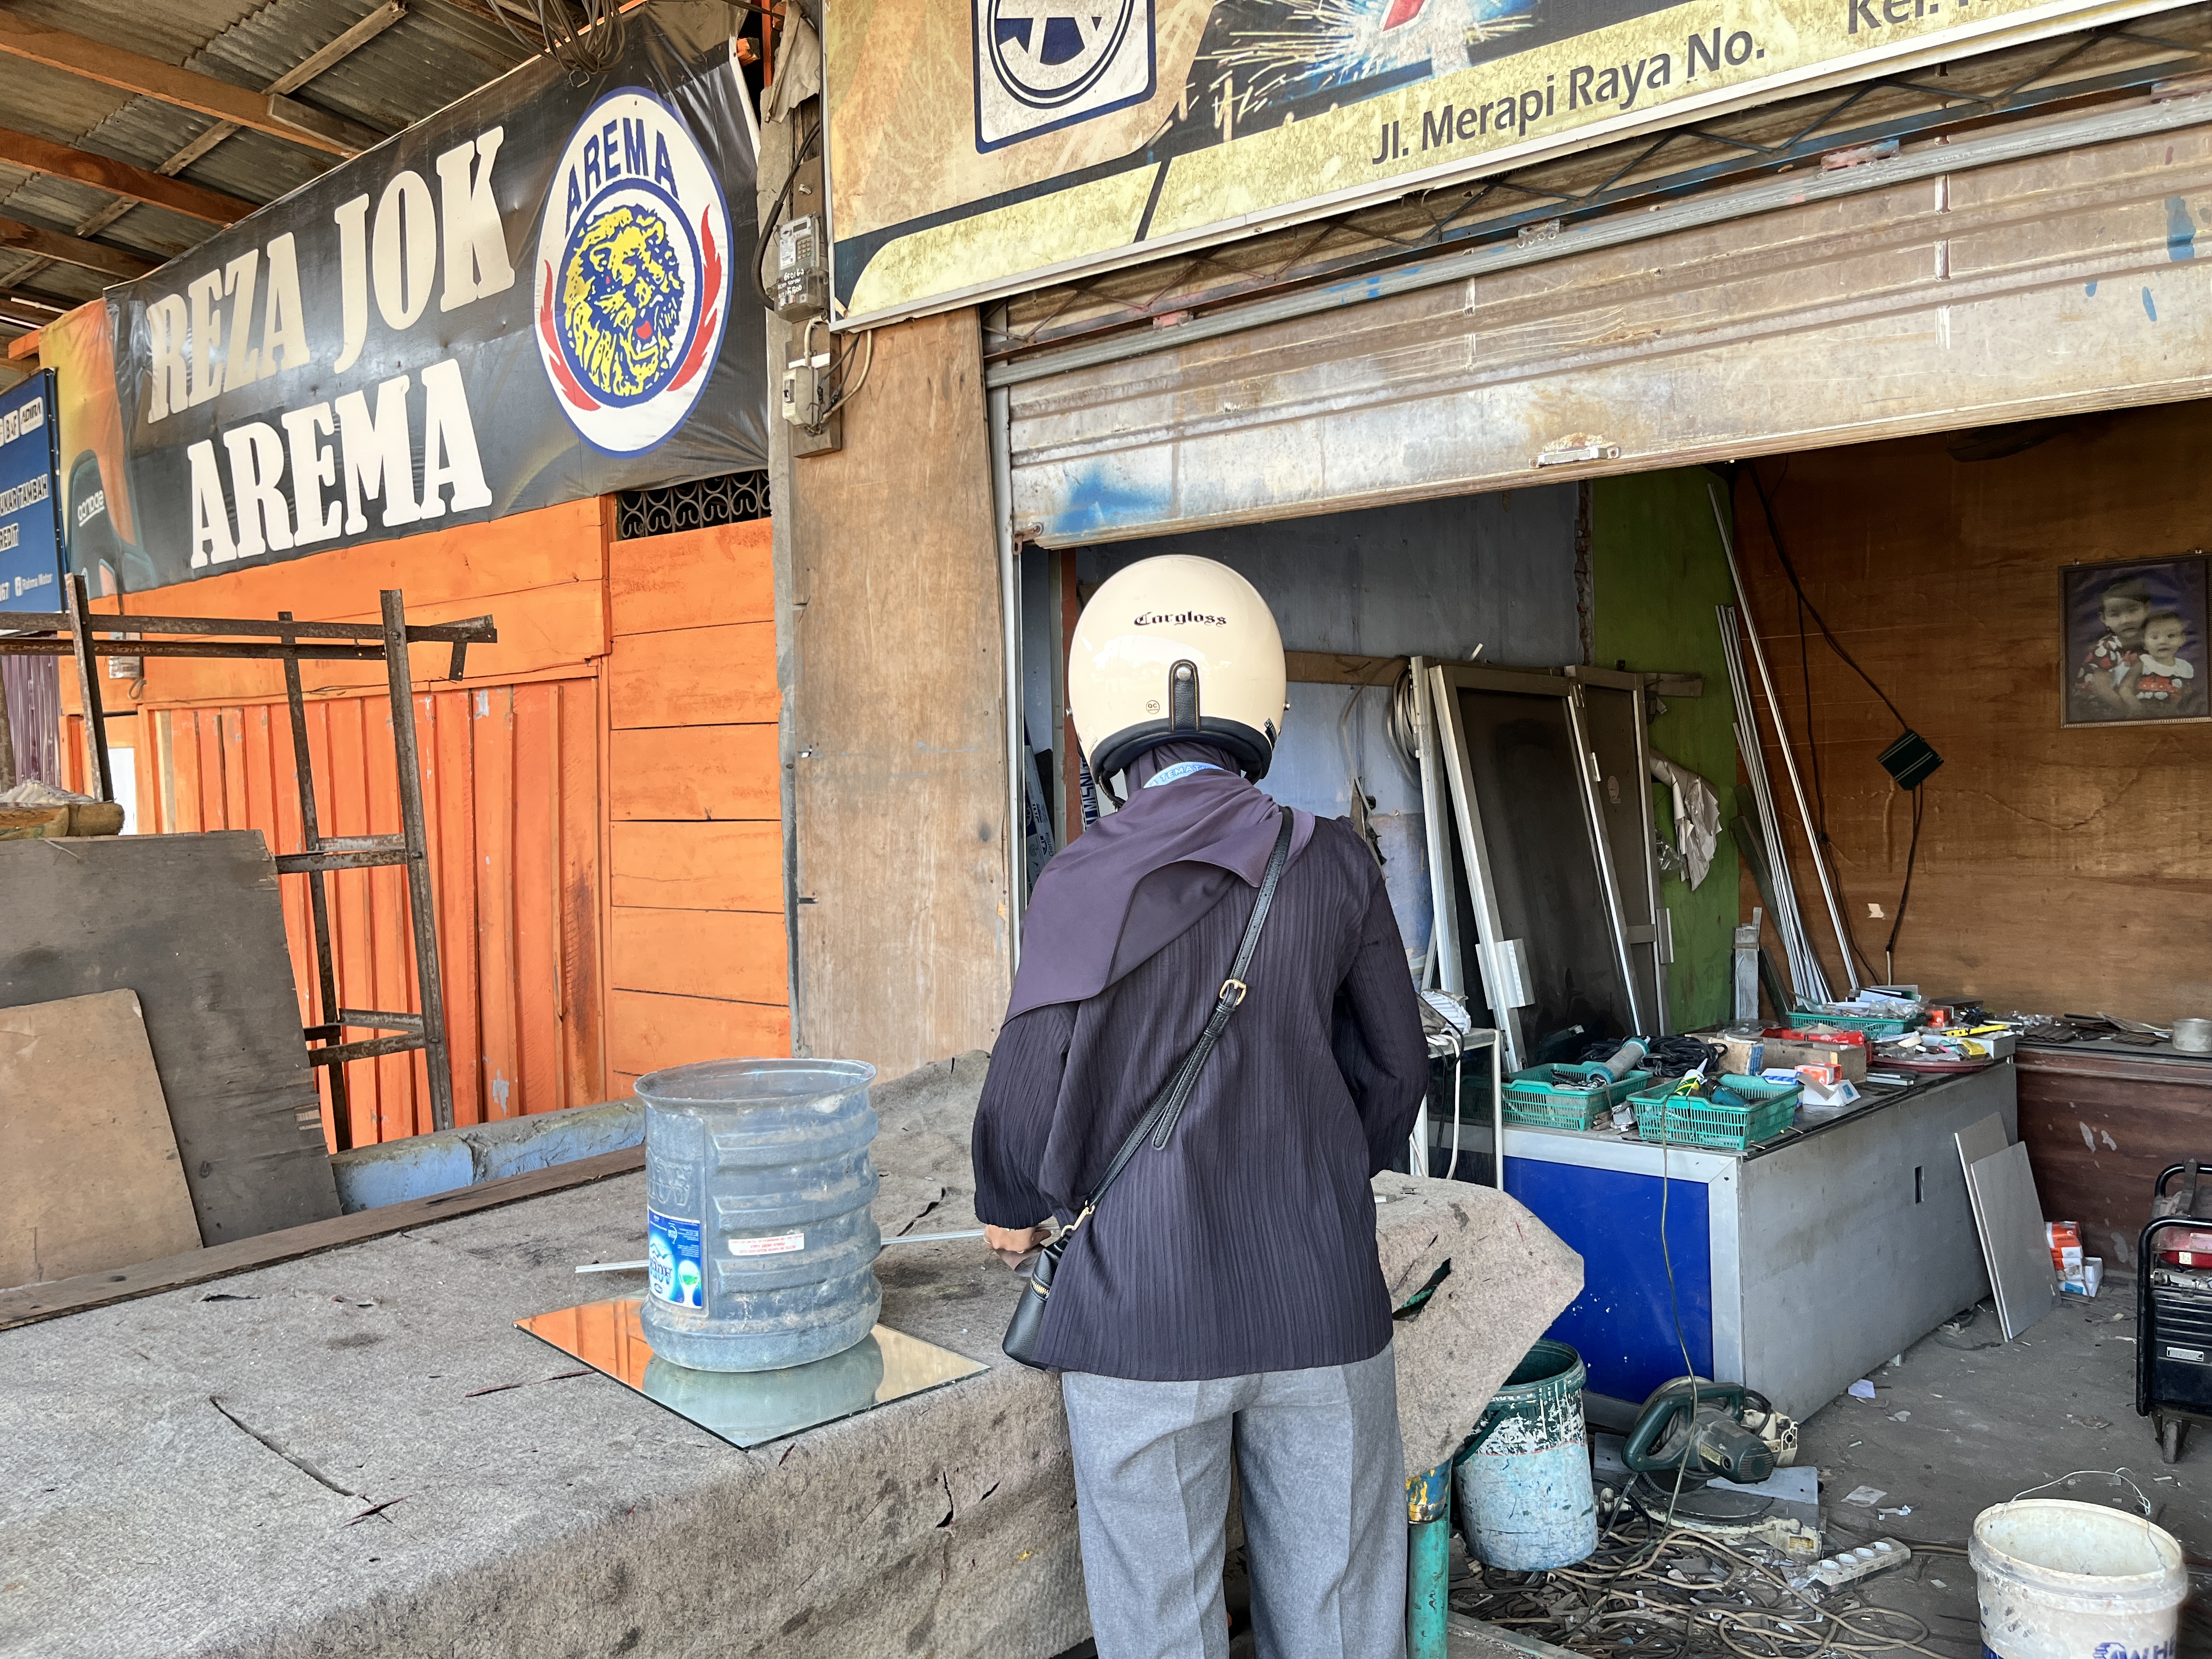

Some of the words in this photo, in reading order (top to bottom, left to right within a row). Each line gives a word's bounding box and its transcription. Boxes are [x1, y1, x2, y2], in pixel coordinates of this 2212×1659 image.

[1372, 120, 1409, 165] Jl.
[1422, 75, 1554, 151] Merapi
[1569, 54, 1671, 110] Raya
[1687, 27, 1765, 78] No.
[566, 117, 679, 237] AREMA
[146, 233, 311, 425] REZA
[334, 126, 515, 374] JOK
[6, 415, 17, 439] BAF
[21, 402, 41, 425] ADIRA
[17, 473, 49, 509] TAMBAH
[188, 358, 493, 569] AREMA
[1134, 611, 1227, 628] Cargloss
